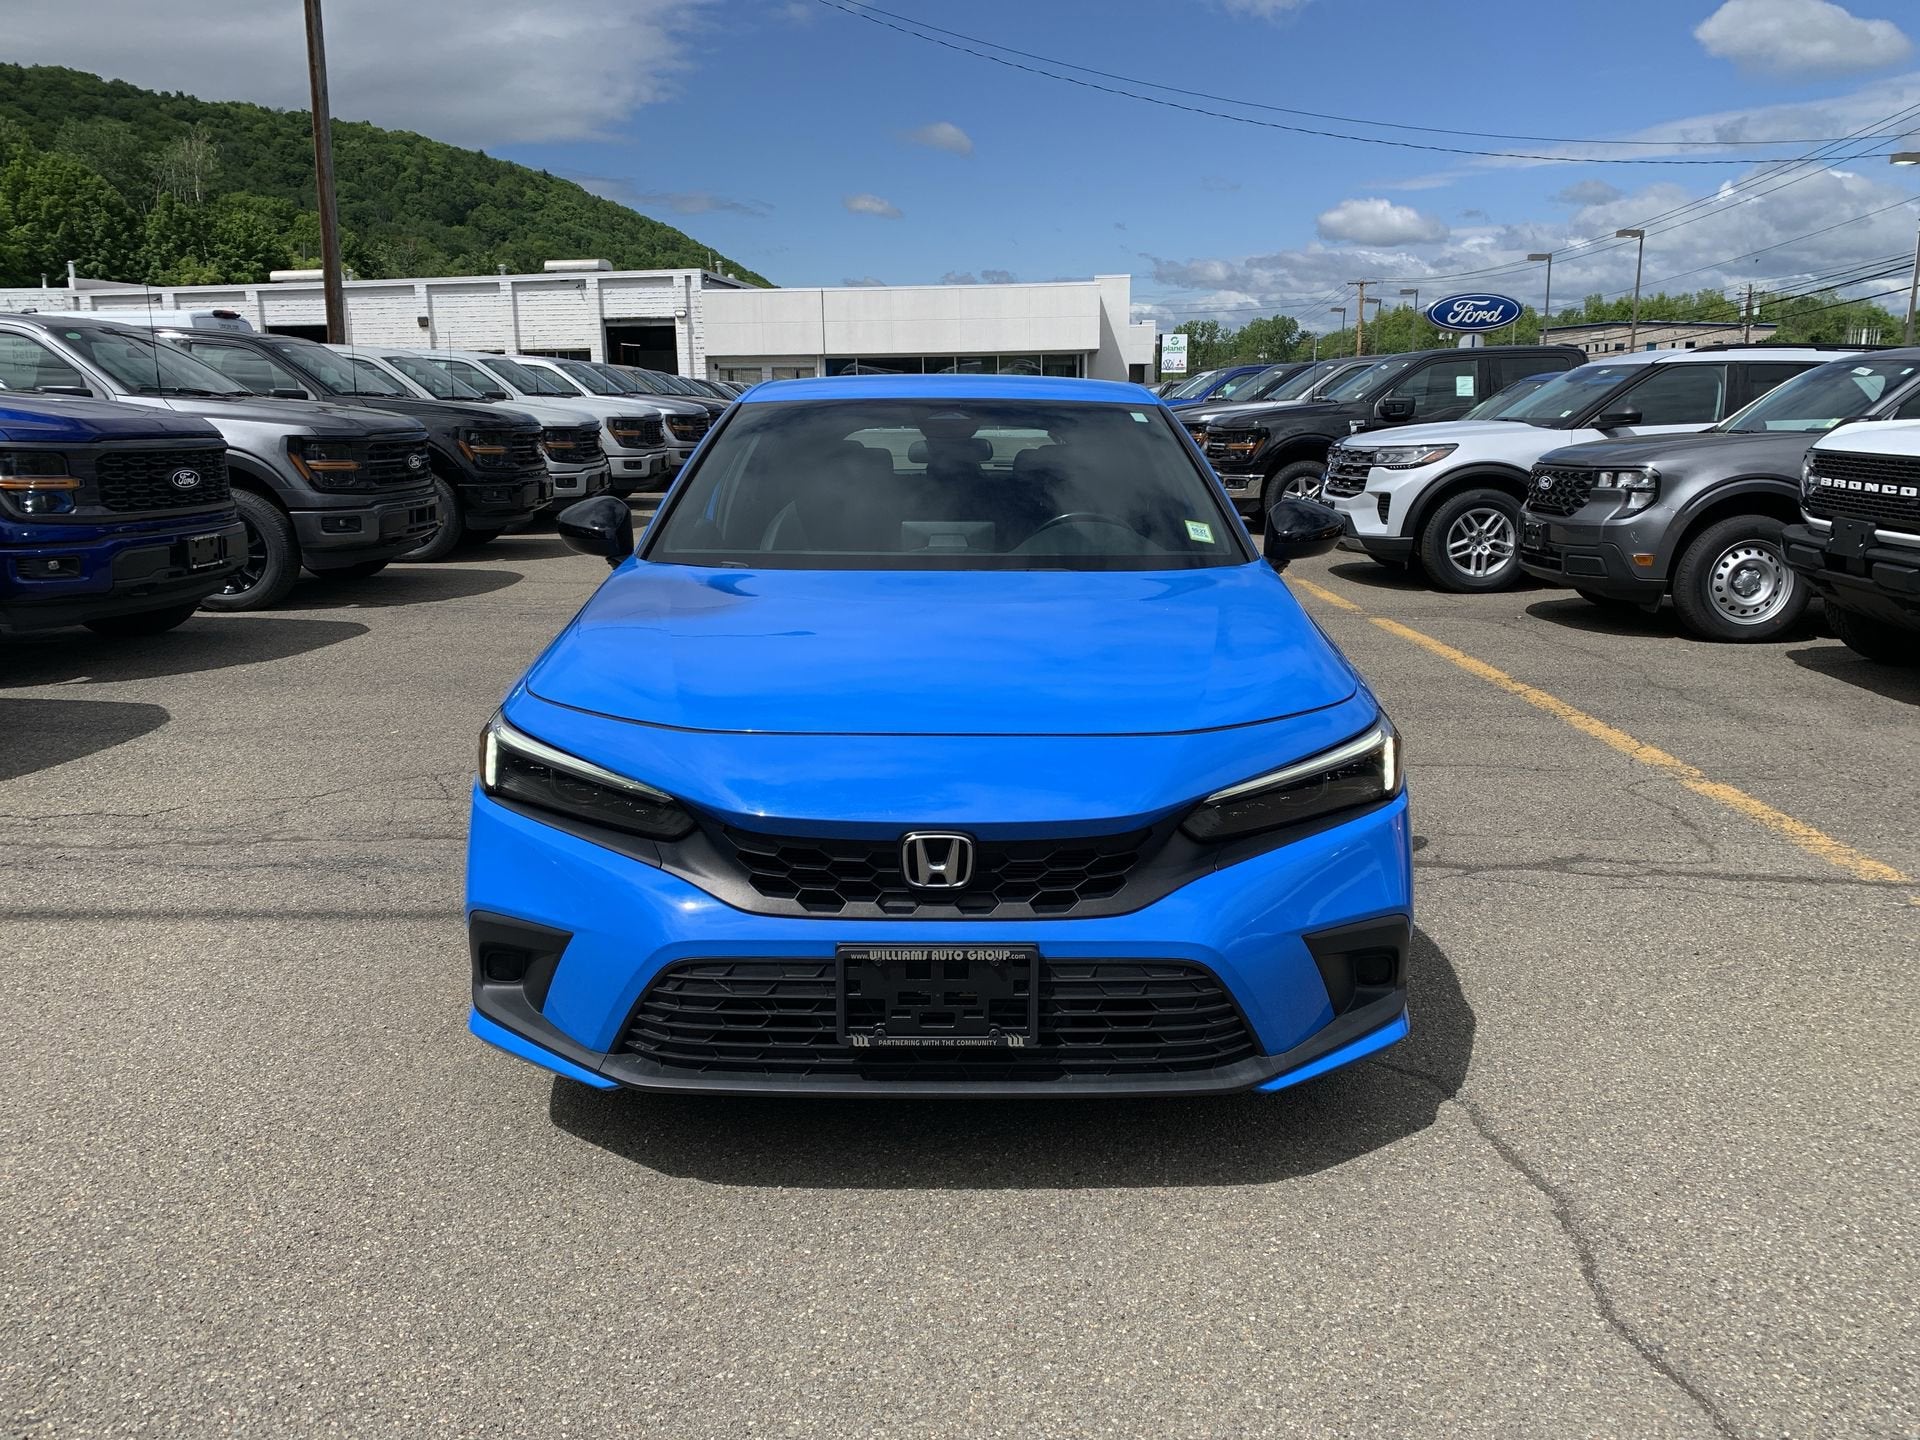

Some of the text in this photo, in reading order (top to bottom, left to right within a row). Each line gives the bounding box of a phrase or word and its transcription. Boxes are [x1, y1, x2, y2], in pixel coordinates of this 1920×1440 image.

[1447, 299, 1505, 324] Ford
[1820, 477, 1918, 497] BRONCO
[931, 950, 964, 961] AUTO
[878, 1039, 998, 1047] PARTNERING WITH THE COMMUNITY
